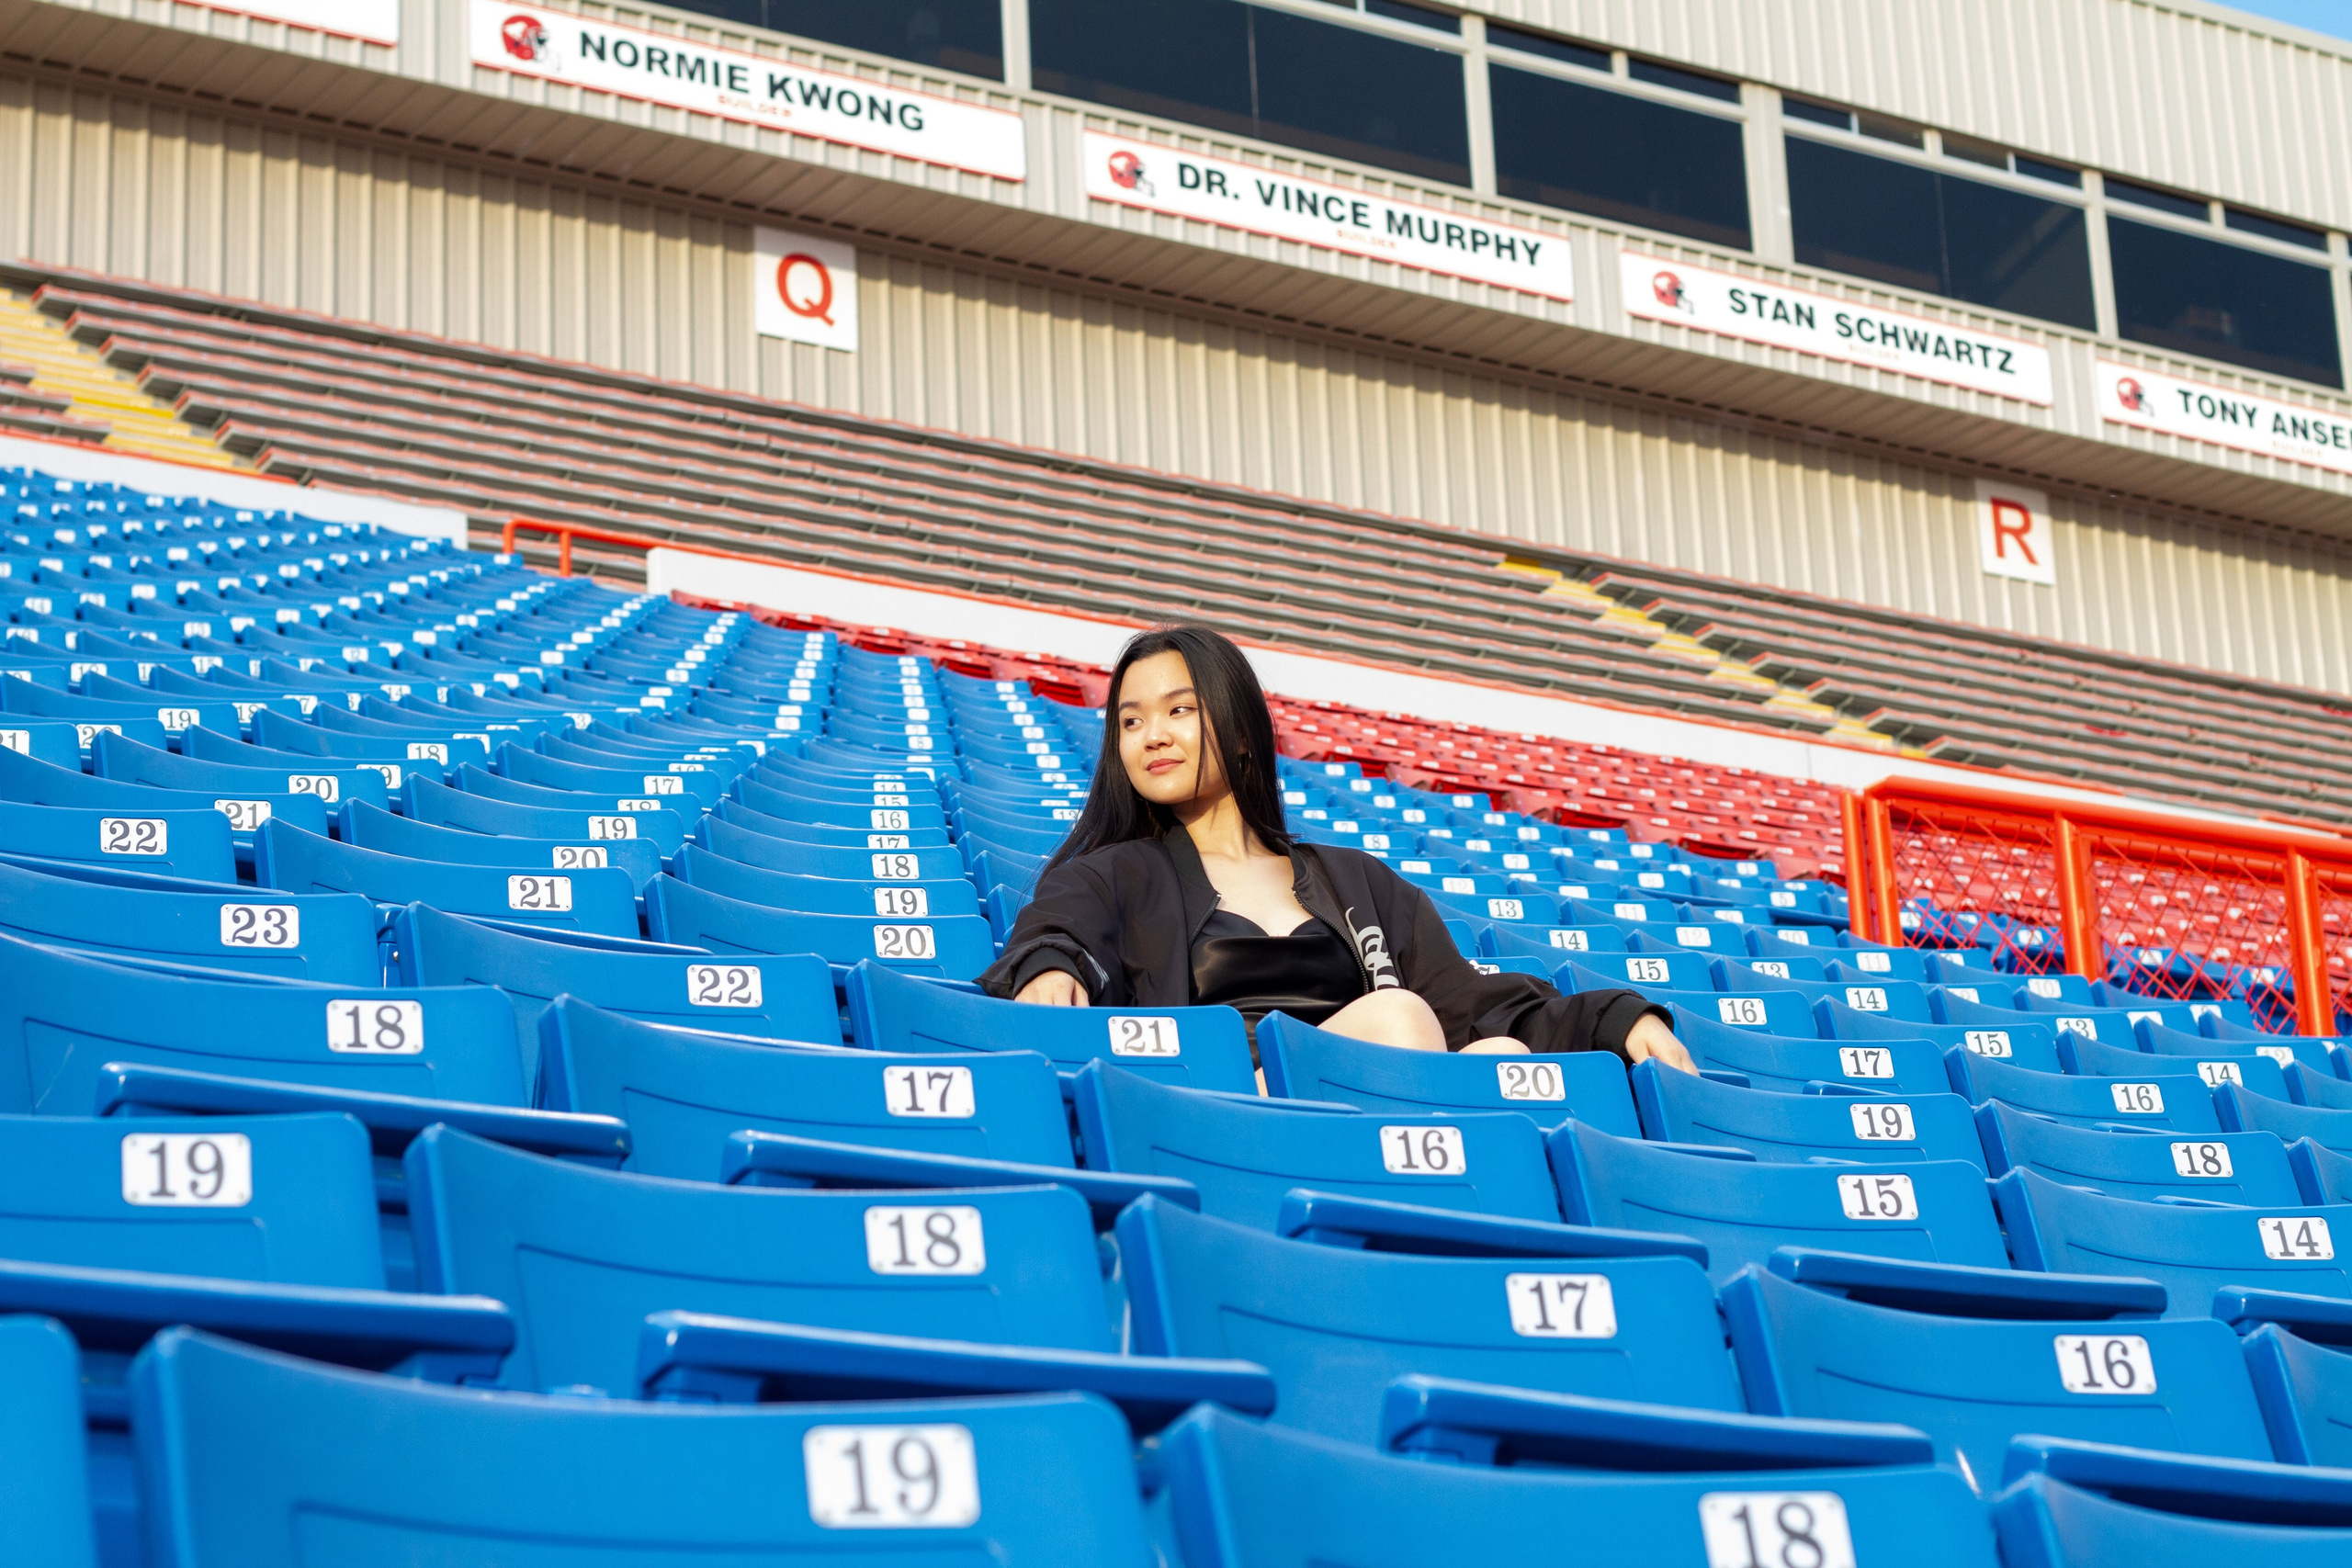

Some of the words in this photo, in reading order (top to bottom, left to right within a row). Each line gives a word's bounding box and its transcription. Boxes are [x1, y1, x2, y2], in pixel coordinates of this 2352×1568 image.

[580, 31, 750, 94] NORMIE
[768, 73, 925, 131] KWONG
[1178, 162, 1239, 200] DR.
[1255, 180, 1371, 228] VINCE
[1385, 209, 1542, 265] MURPHY
[776, 253, 834, 327] Q
[1729, 288, 1815, 330] STAN
[1836, 313, 2016, 374] SCHWARTZ
[2177, 389, 2257, 428] TONY
[2272, 412, 2352, 452] ANSE
[1990, 496, 2040, 566] R
[166, 710, 192, 729] 19
[415, 745, 440, 761] 18
[295, 776, 333, 801] 20
[651, 777, 675, 795] 17
[225, 802, 259, 829] 21
[597, 818, 628, 840] 19
[878, 811, 902, 829] 16
[108, 819, 158, 853] 22
[876, 837, 900, 848] 17
[1372, 835, 1381, 848] 8
[560, 849, 602, 868] 20
[879, 855, 911, 878] 18
[519, 877, 560, 908] 21
[884, 889, 919, 917] 19
[1495, 900, 1519, 918] 13
[232, 907, 288, 945] 23
[1555, 931, 1582, 950] 14
[1682, 929, 1702, 944] 12
[881, 927, 927, 957] 20
[1634, 960, 1662, 981] 15
[1864, 954, 1884, 970] 11
[696, 968, 752, 1005] 22
[1854, 989, 1881, 1010] 14
[2034, 981, 2054, 997] 10
[1727, 999, 1758, 1023] 16
[345, 1004, 406, 1051] 18
[1122, 1019, 1167, 1054] 21
[1974, 1033, 2004, 1057] 15
[1849, 1049, 1881, 1077] 17
[2207, 1065, 2233, 1085] 14
[901, 1071, 955, 1113] 17
[1507, 1065, 1555, 1097] 20
[2121, 1085, 2154, 1111] 16
[1862, 1105, 1903, 1139] 19
[1396, 1129, 1449, 1172] 16
[2181, 1144, 2222, 1176] 18
[148, 1140, 225, 1200] 19
[1852, 1178, 1902, 1218] 15
[888, 1211, 963, 1269] 18
[2272, 1220, 2321, 1258] 14
[1528, 1280, 1589, 1333] 17
[2074, 1340, 2137, 1391] 16
[841, 1436, 943, 1518] 19
[1731, 1498, 1827, 1568] 18
